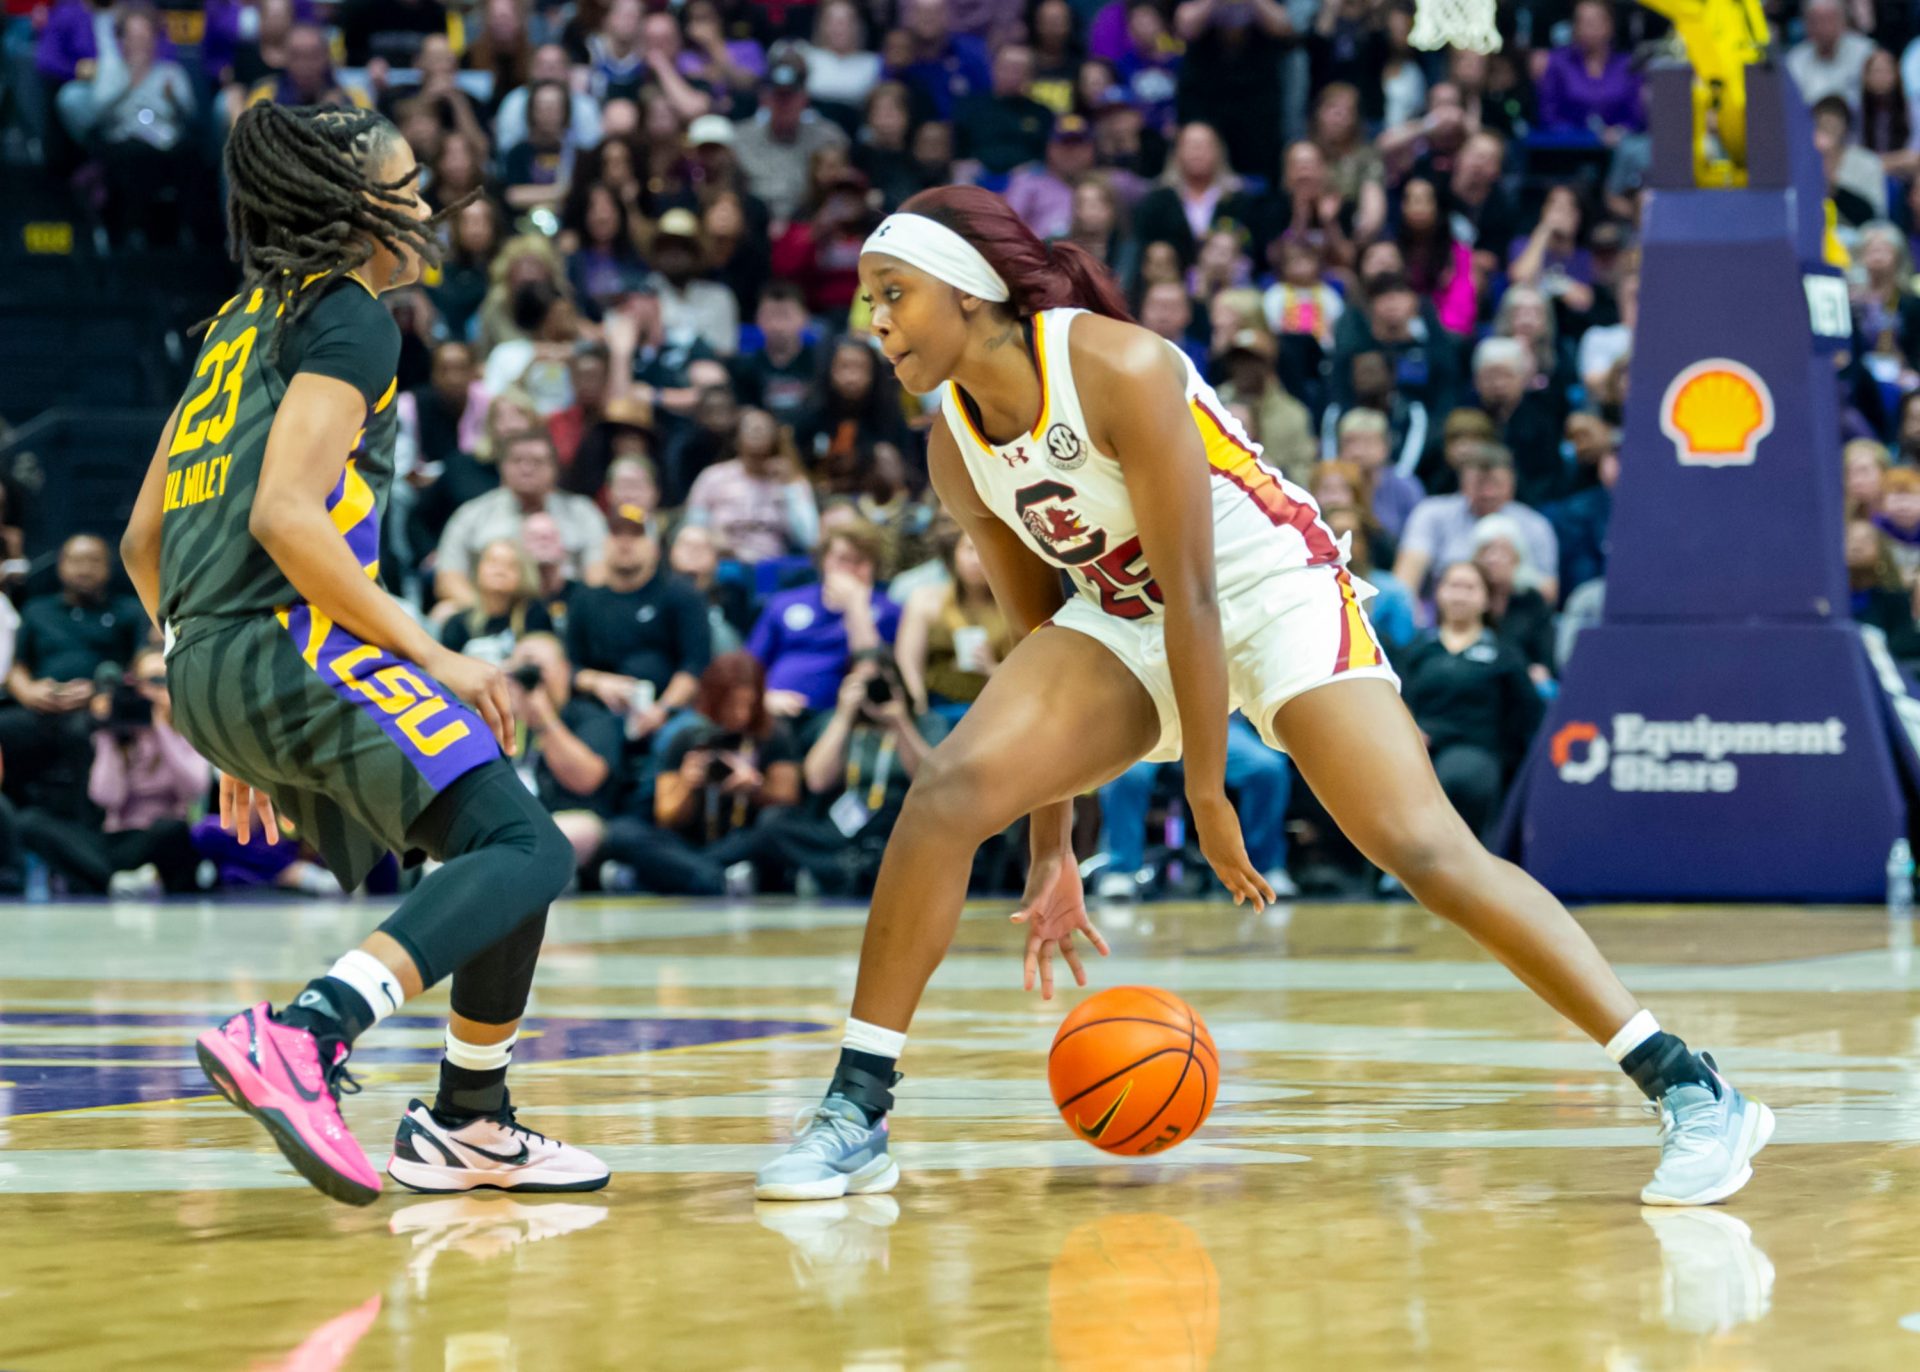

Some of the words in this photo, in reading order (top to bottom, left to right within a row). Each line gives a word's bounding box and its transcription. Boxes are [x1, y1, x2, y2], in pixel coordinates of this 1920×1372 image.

[168, 326, 258, 457] 23
[163, 453, 232, 513] ULWILEY
[329, 644, 470, 756] LSU
[1612, 713, 1846, 760] Equipment
[1610, 754, 1738, 792] Share
